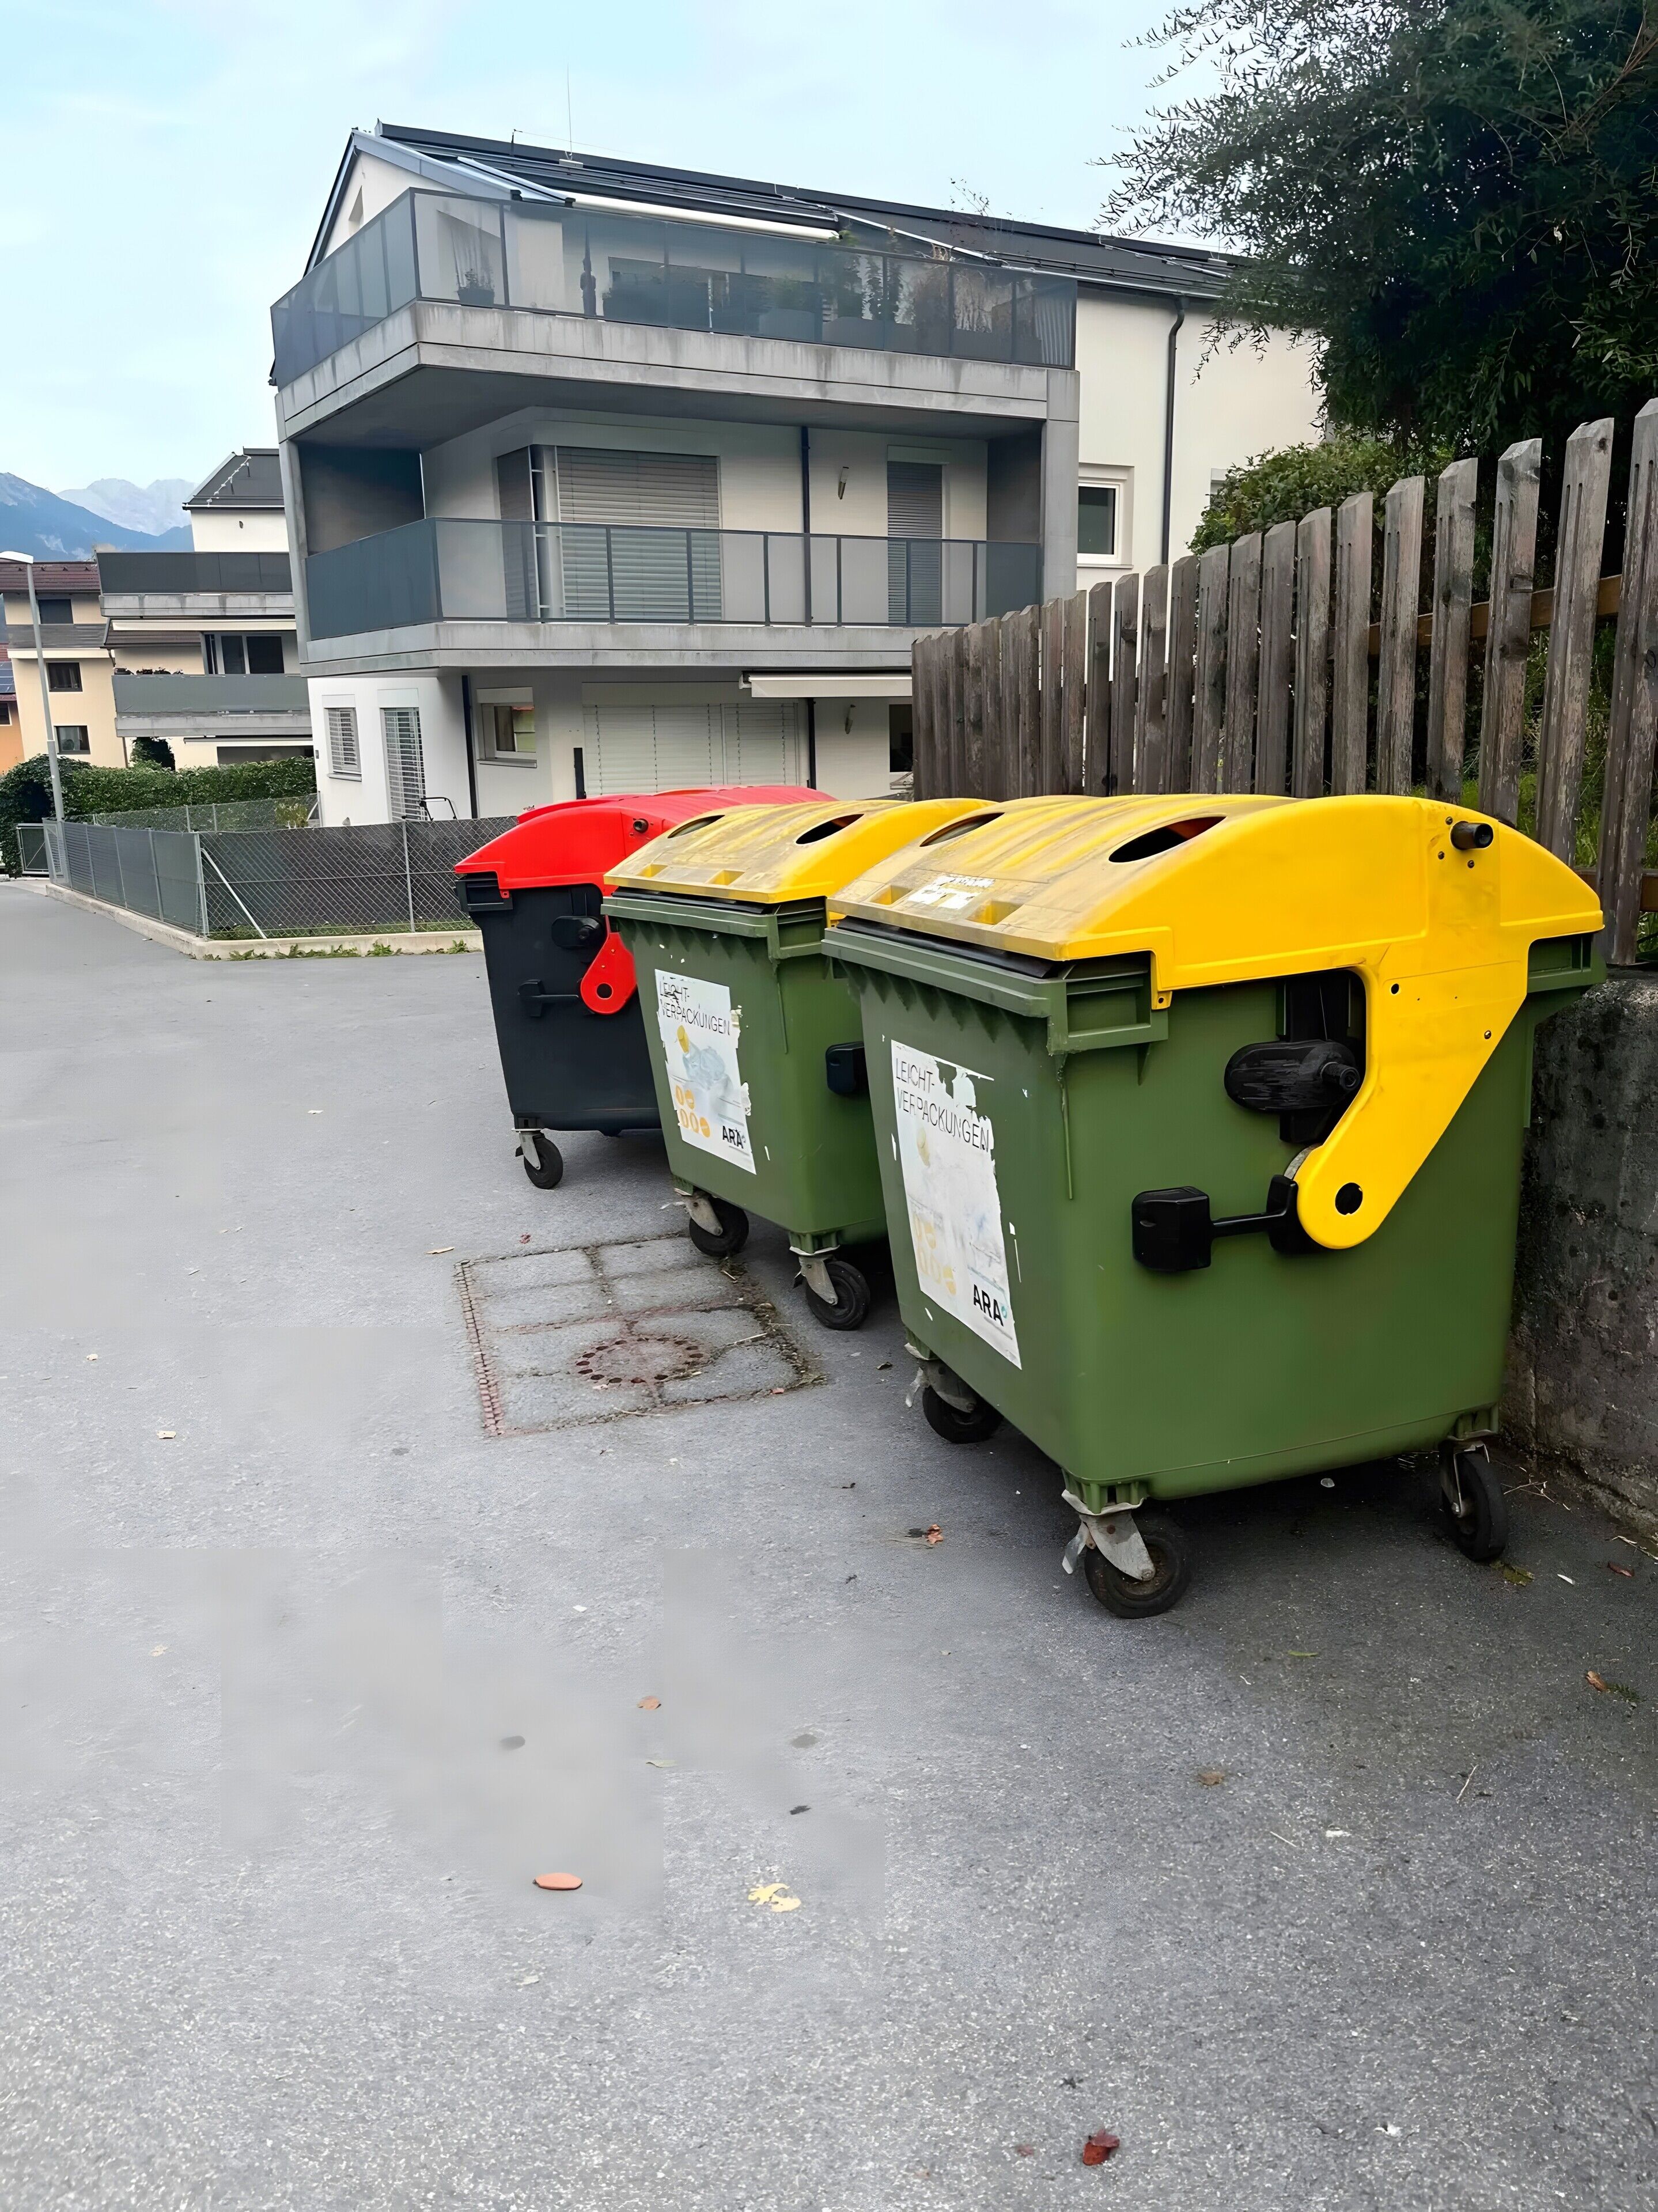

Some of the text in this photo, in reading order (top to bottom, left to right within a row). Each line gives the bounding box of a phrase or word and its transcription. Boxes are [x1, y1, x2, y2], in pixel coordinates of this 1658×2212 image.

[896, 1058, 934, 1093] LEICHT-
[722, 1126, 744, 1149] ARA
[897, 1087, 989, 1153] VERPACKUNGEN
[974, 1284, 1004, 1327] ARA
